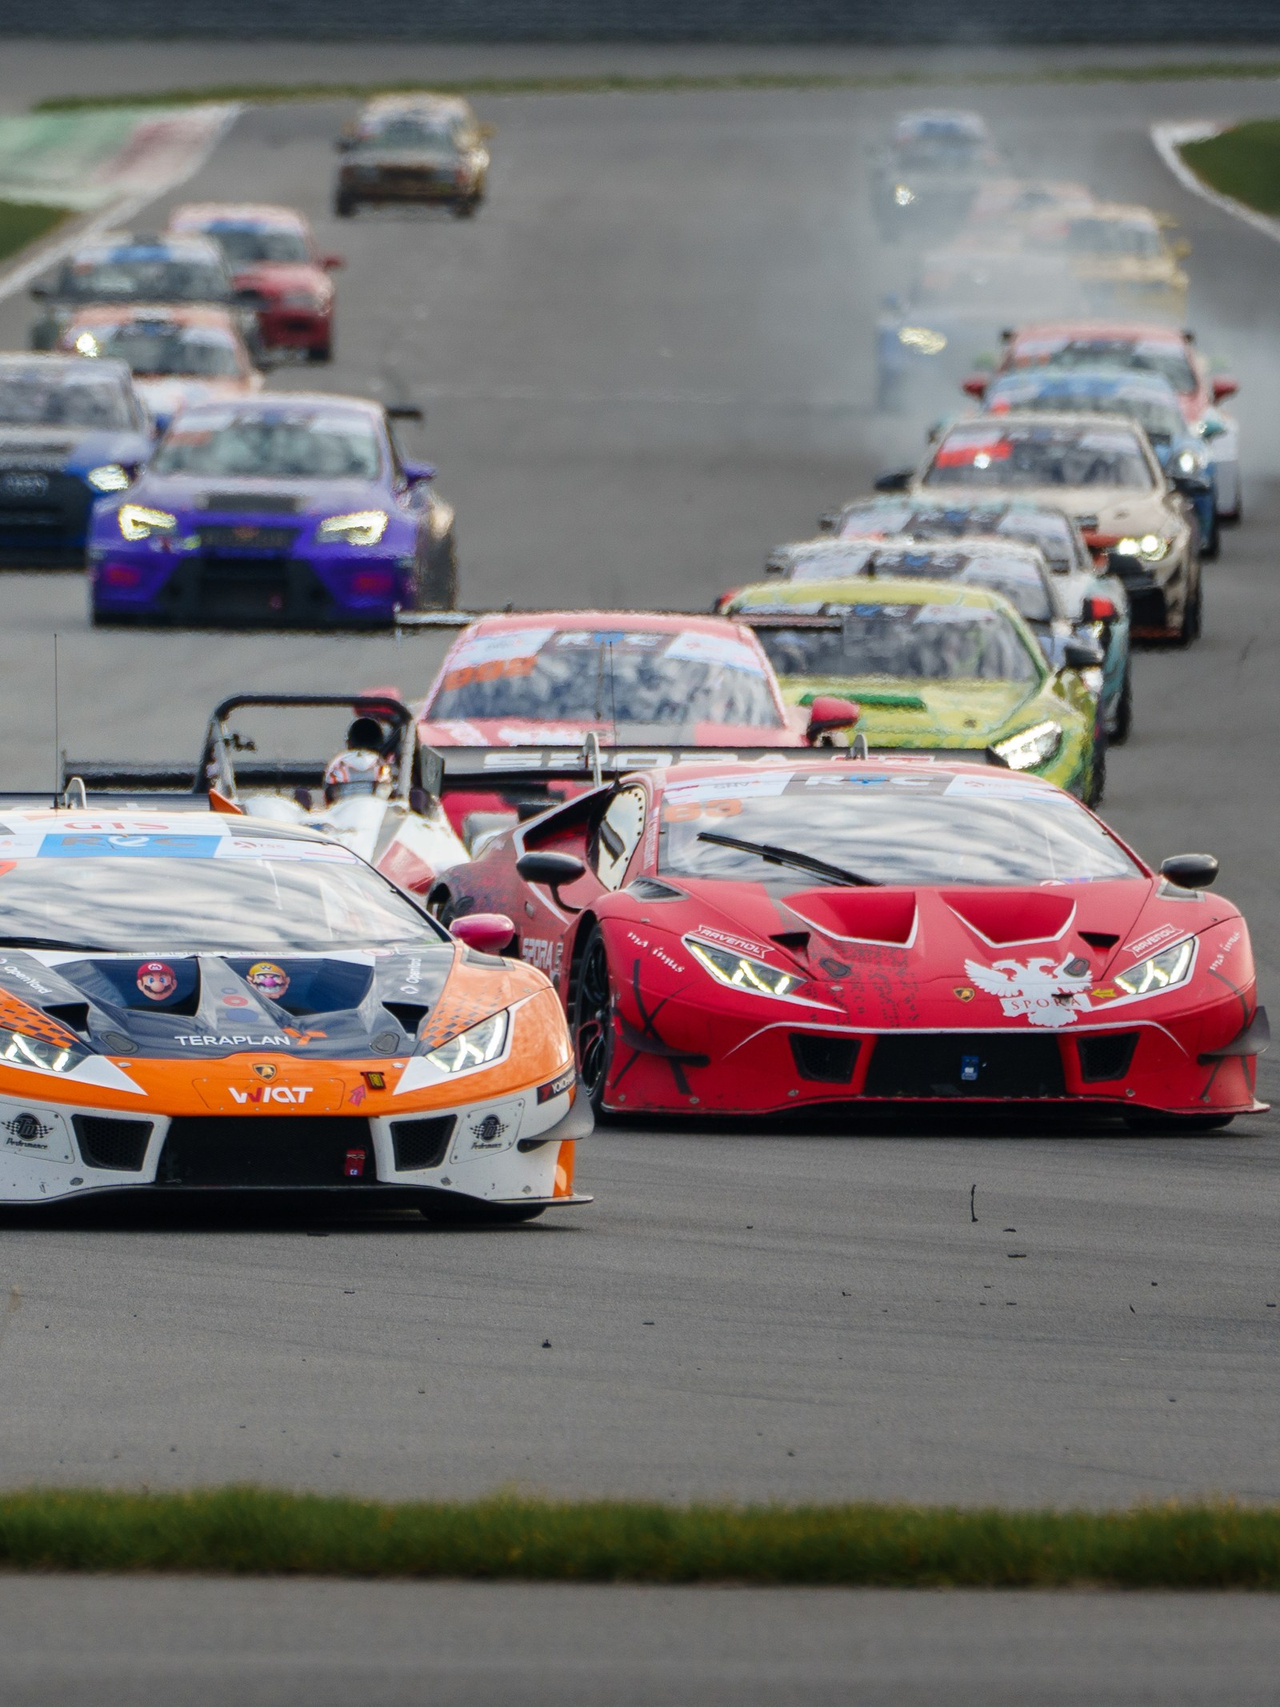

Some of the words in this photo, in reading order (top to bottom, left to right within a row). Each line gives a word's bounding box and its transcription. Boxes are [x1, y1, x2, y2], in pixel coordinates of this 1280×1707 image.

[702, 928, 763, 953] RAVENOL
[1131, 927, 1175, 953] RAVENOL
[4, 965, 53, 994] OpenYard
[1011, 997, 1081, 1011] SPORA
[174, 1036, 291, 1046] TERAPLAN
